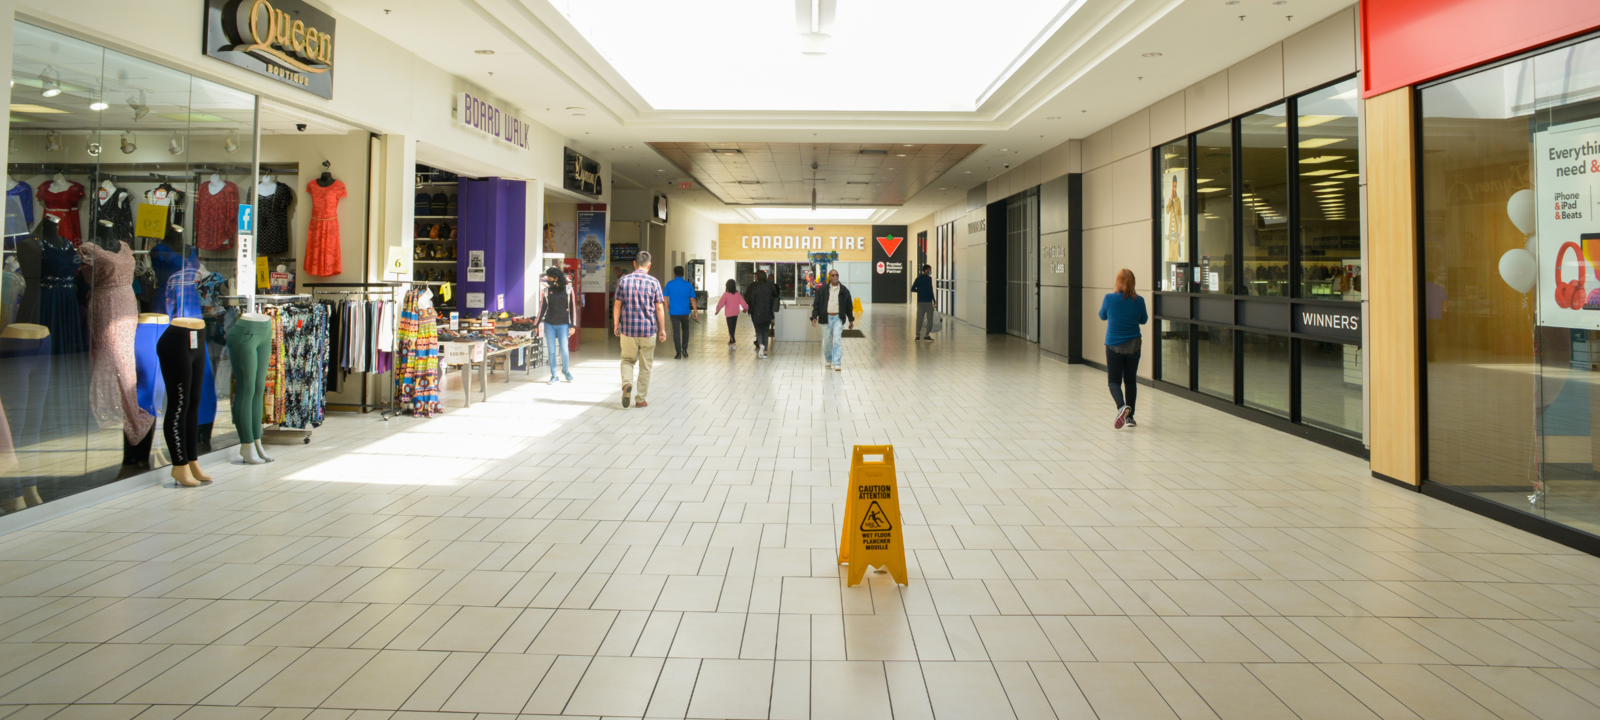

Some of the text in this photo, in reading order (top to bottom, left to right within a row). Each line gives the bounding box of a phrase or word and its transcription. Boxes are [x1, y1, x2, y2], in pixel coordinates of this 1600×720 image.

[247, 0, 332, 73] Queen
[267, 63, 309, 86] BOUTIQUE
[465, 93, 530, 151] BOARD WALK
[1548, 140, 1600, 161] Everythi
[1556, 160, 1587, 177] need
[1554, 192, 1579, 201] iPhone
[1555, 200, 1577, 210] & iPad
[1555, 210, 1583, 220] & Beats
[741, 235, 865, 250] CANADIAN TIRE
[394, 258, 402, 269] 6
[1302, 311, 1359, 331] WINNERS
[858, 485, 891, 493] CAUTION
[858, 492, 891, 500] ATTENTION
